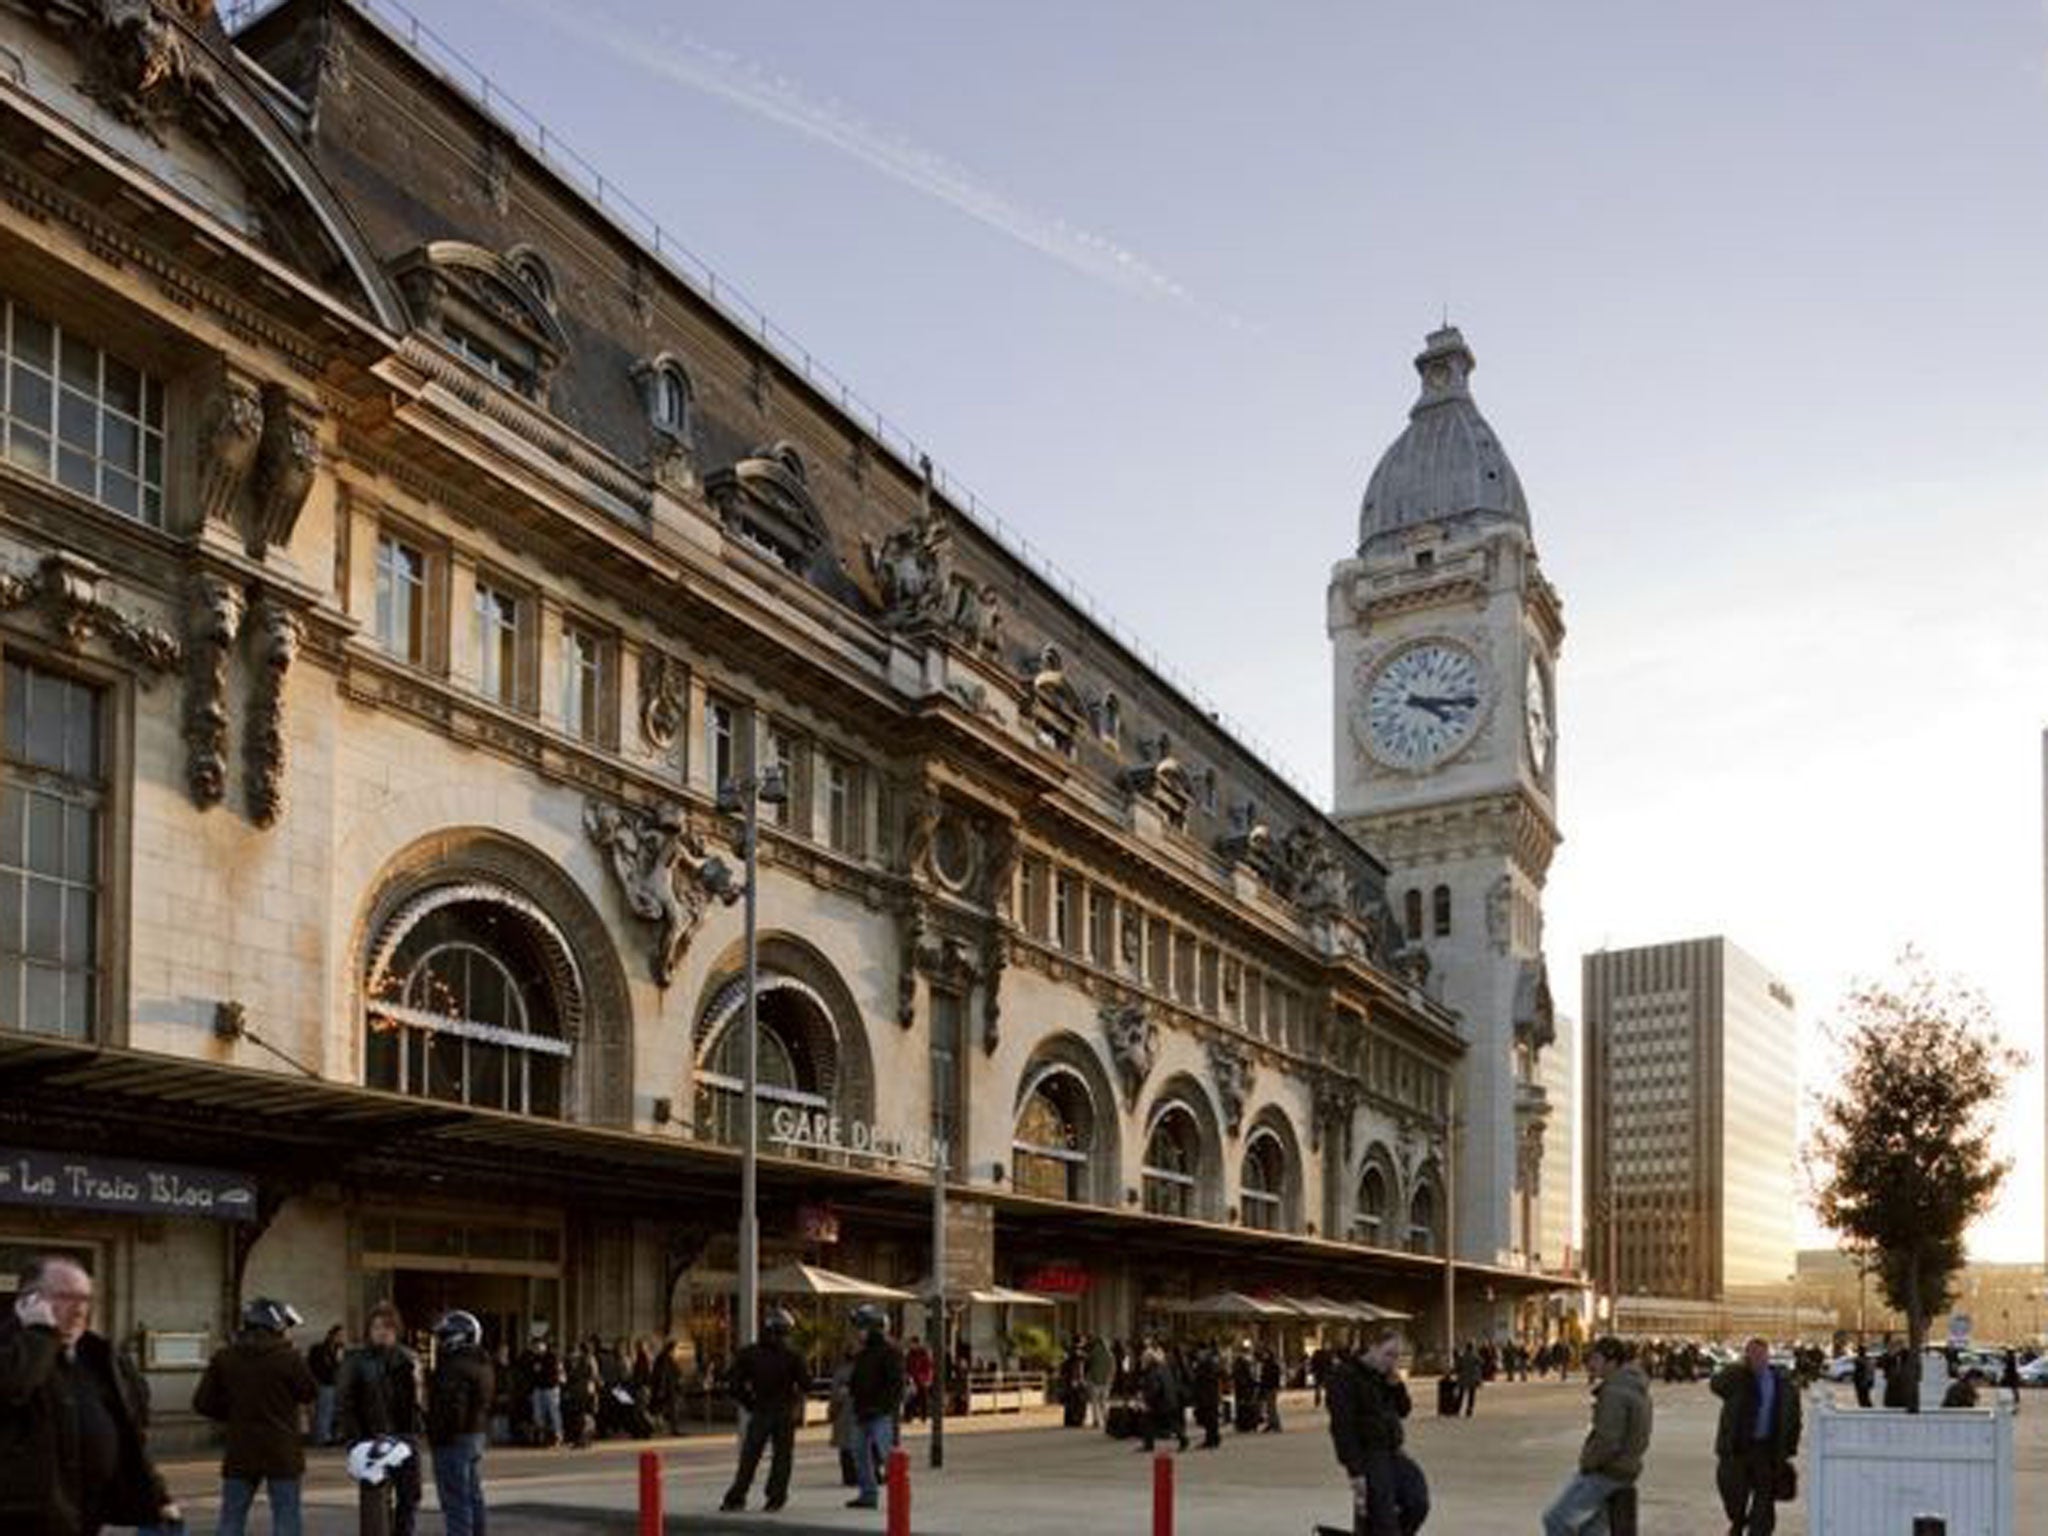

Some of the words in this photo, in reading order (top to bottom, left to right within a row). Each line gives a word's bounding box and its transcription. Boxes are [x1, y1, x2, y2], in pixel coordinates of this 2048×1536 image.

[773, 1106, 842, 1147] GARE
[852, 1120, 882, 1153] DE
[19, 1160, 55, 1194] Le
